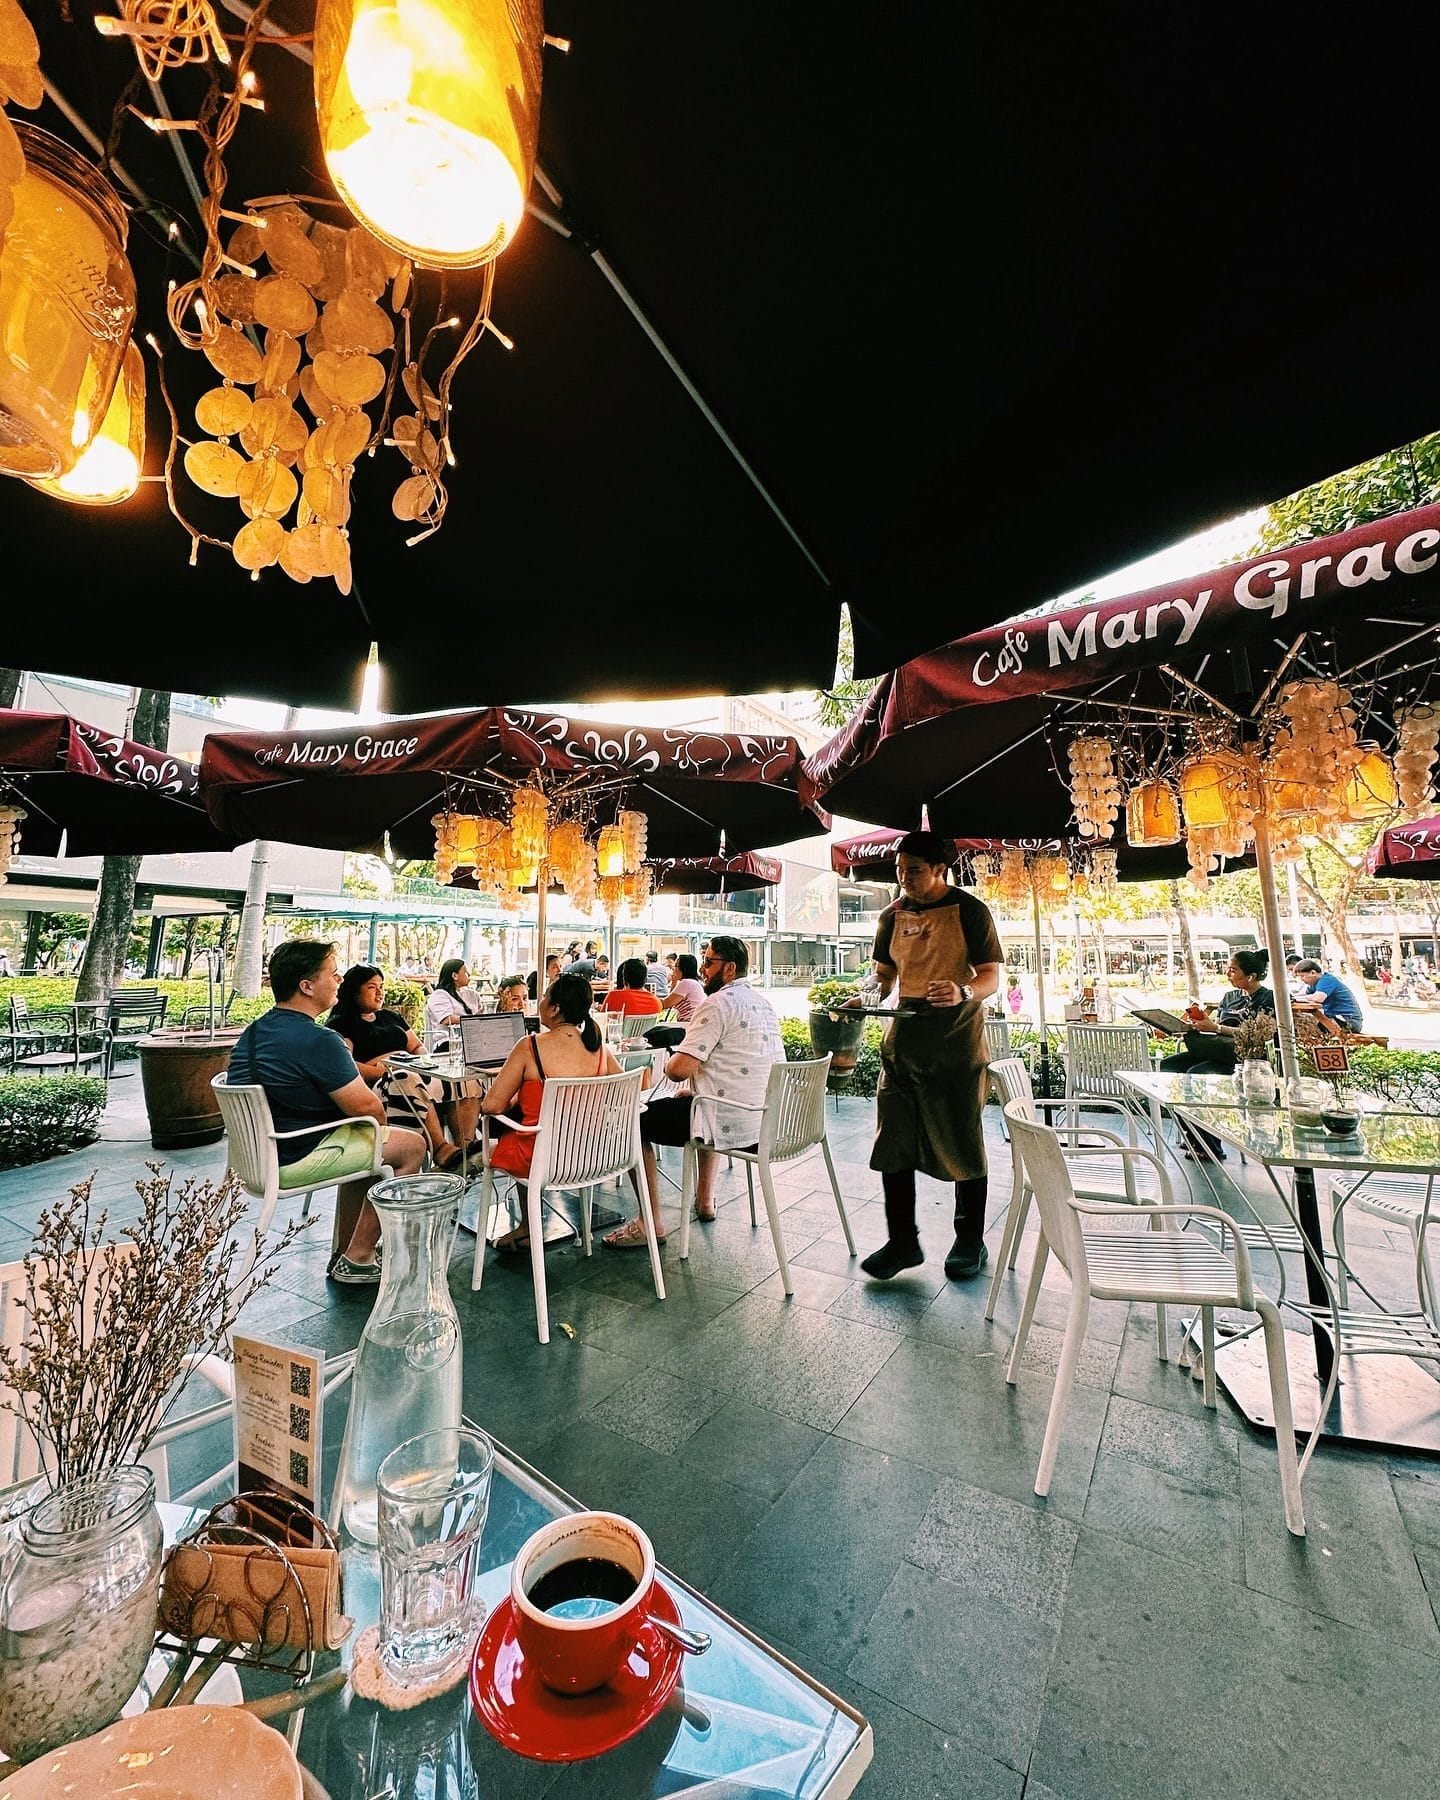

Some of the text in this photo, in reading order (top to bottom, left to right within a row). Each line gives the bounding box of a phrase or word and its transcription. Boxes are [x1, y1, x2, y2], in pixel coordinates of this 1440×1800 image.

[971, 528, 1440, 687] Cafe Mary Grac
[254, 735, 419, 766] Cafe Mary Grace
[858, 842, 891, 858] Mary
